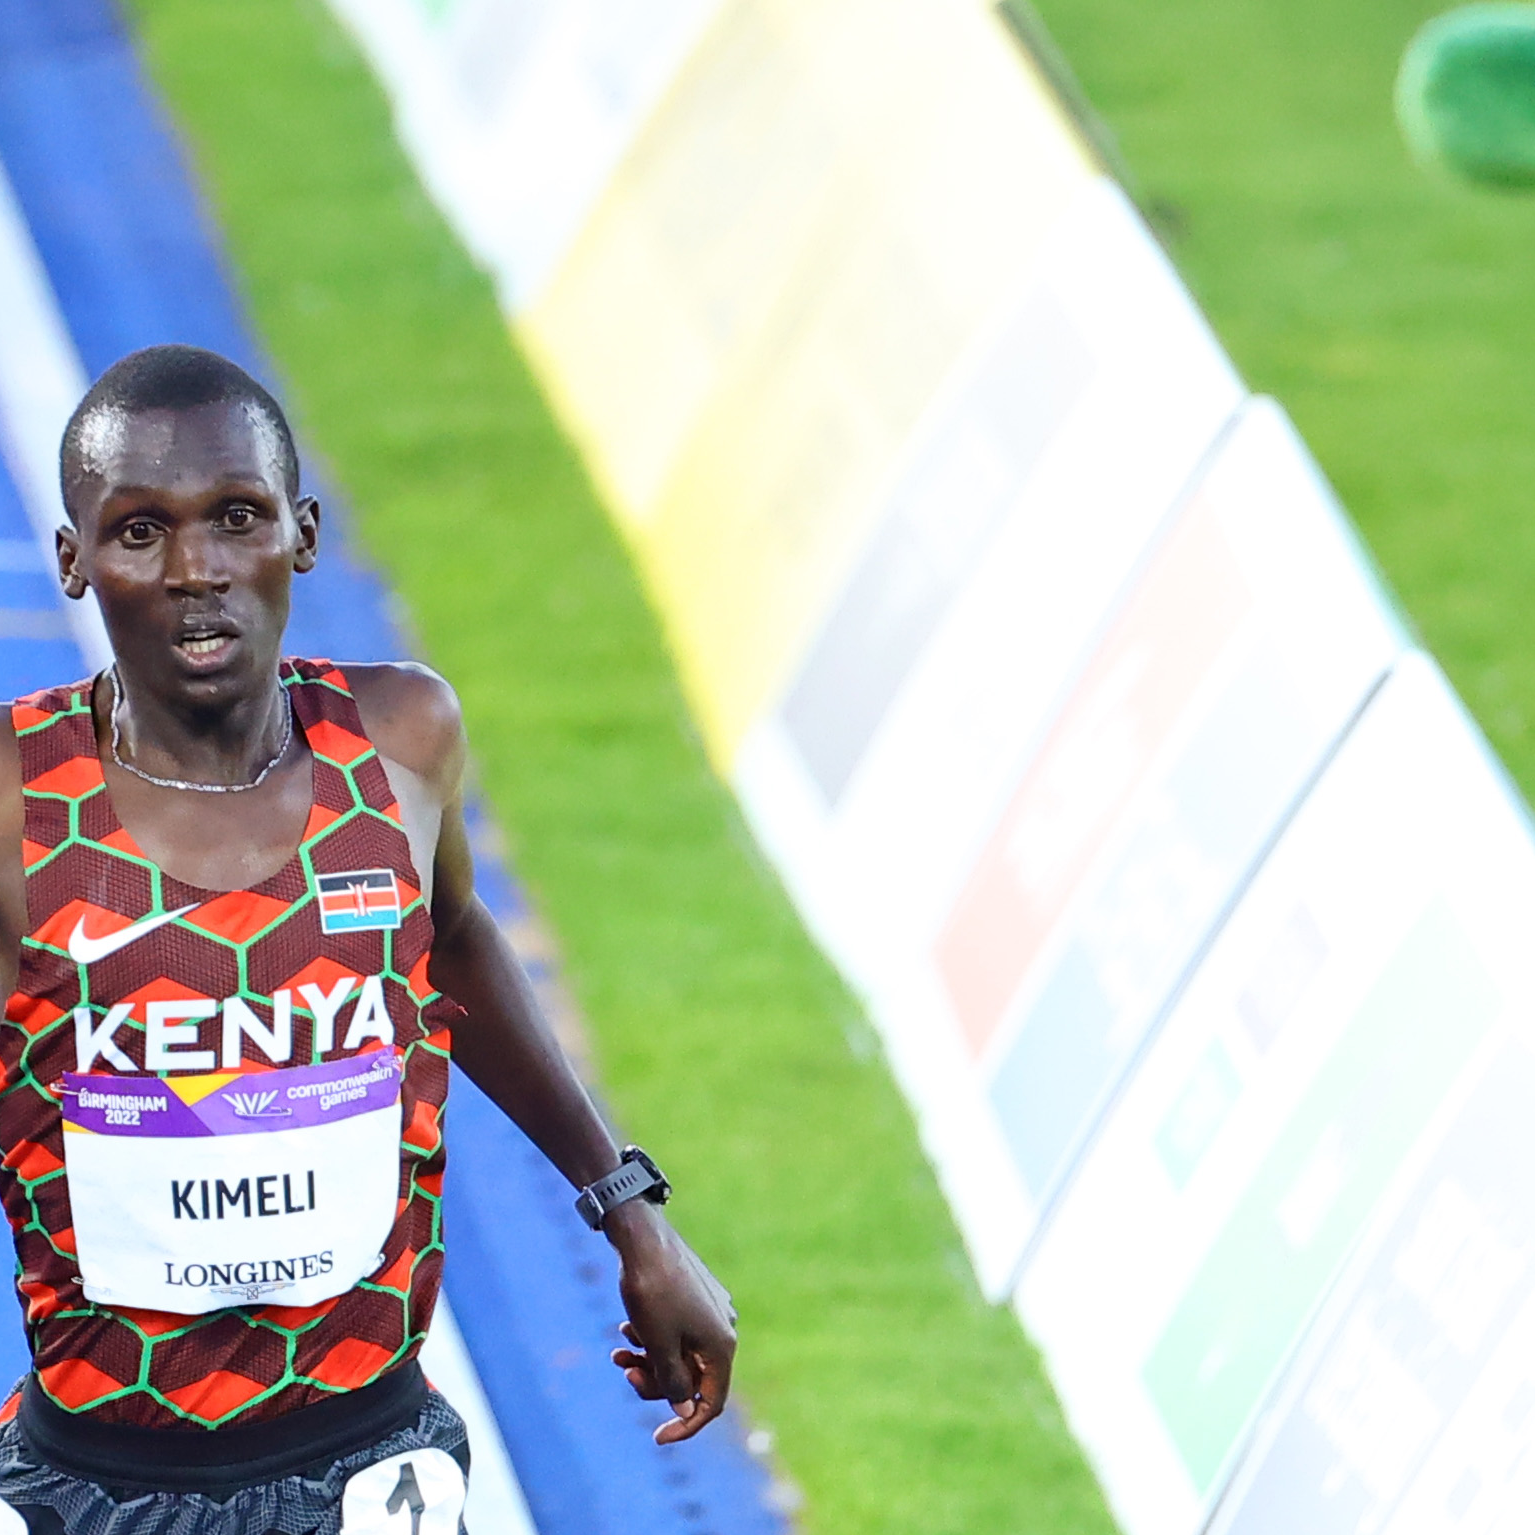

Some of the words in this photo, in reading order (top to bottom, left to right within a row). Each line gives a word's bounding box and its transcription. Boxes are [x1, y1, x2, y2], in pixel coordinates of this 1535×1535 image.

[73, 974, 396, 1074] KENYA
[286, 1065, 393, 1100] commonwealth
[319, 1087, 368, 1111] games
[78, 1090, 168, 1113] BIRMINGHAM
[105, 1109, 142, 1126] 2022
[170, 1169, 317, 1221] KIMELI
[163, 1250, 335, 1288] LONGINES
